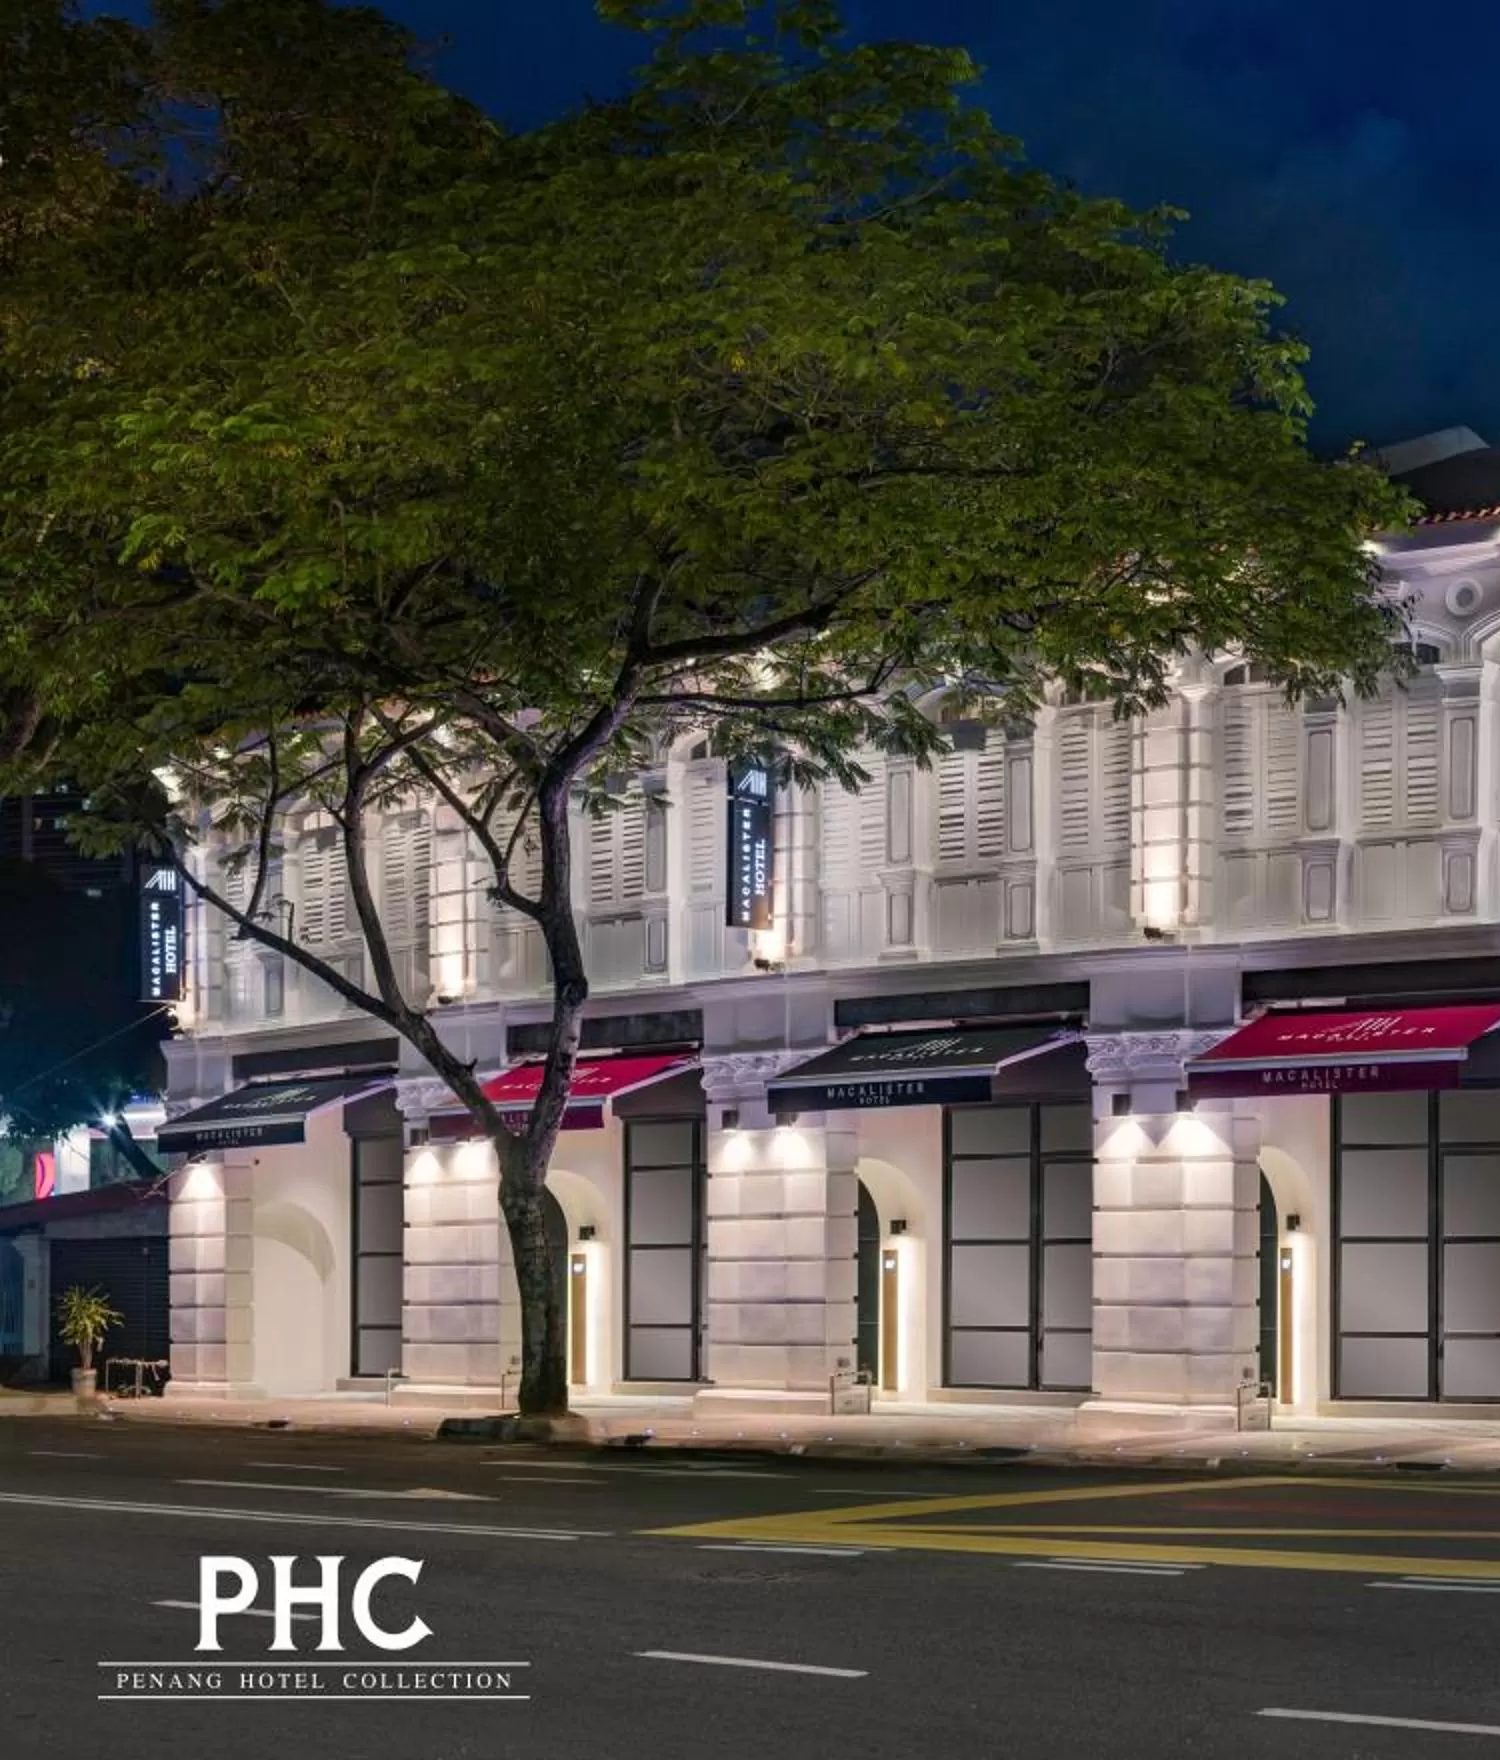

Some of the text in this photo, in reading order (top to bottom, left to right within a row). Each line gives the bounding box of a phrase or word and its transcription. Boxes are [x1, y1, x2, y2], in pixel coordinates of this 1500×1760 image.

[741, 808, 752, 922] MACALISTER
[755, 838, 767, 897] HOTEL
[164, 924, 177, 974] HOTEL
[827, 1082, 924, 1098] MACALISTER
[1262, 1066, 1379, 1082] MACALISTER
